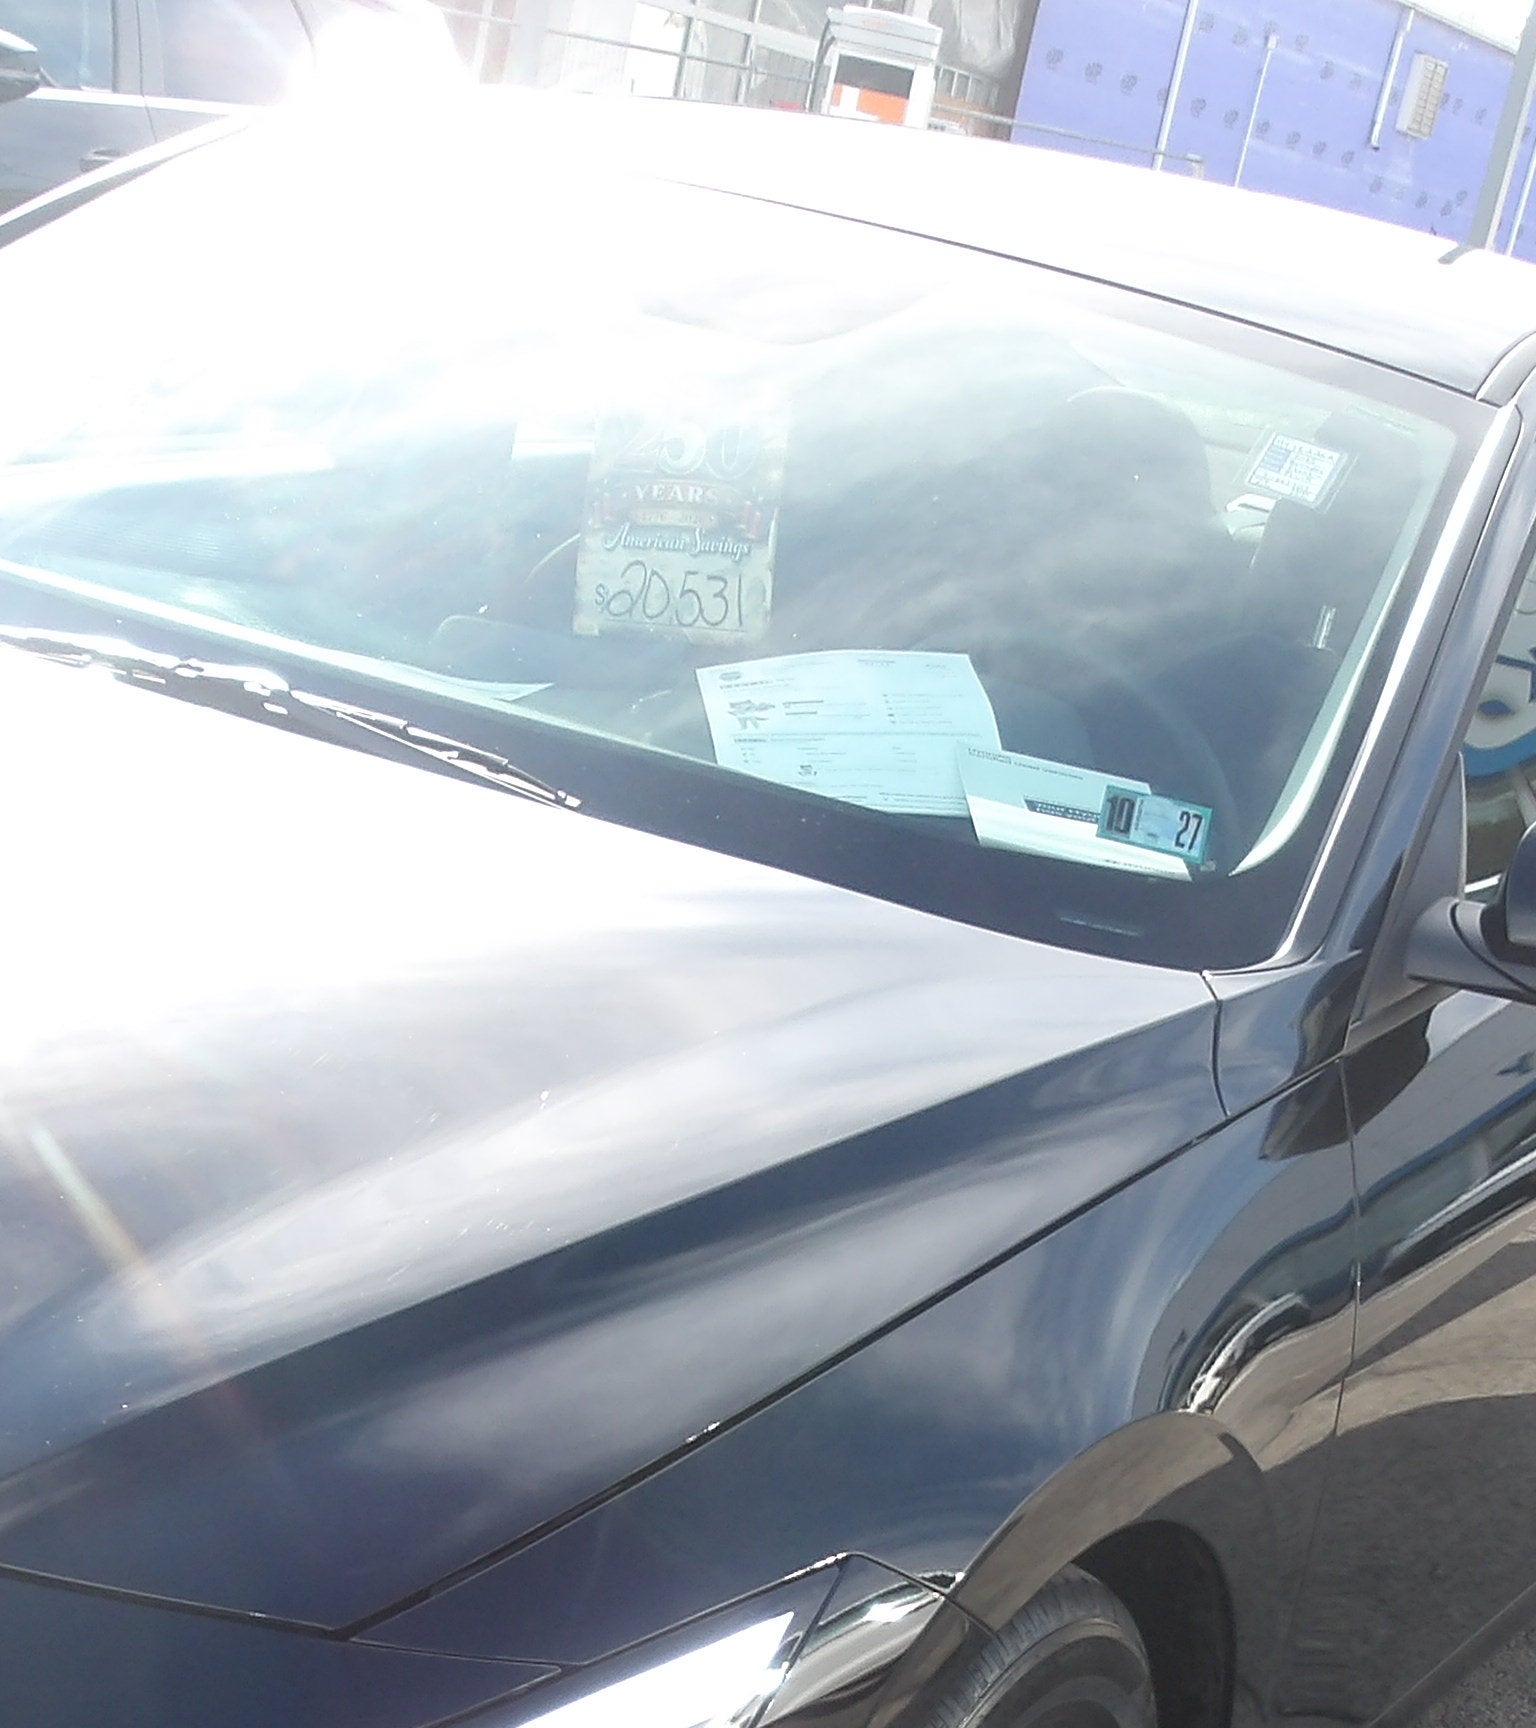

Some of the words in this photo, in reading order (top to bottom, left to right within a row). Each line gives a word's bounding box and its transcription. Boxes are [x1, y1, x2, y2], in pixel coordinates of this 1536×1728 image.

[634, 484, 719, 506] YEARS
[604, 522, 686, 553] American
[688, 527, 751, 562] Savings
[1174, 810, 1203, 852] 27
